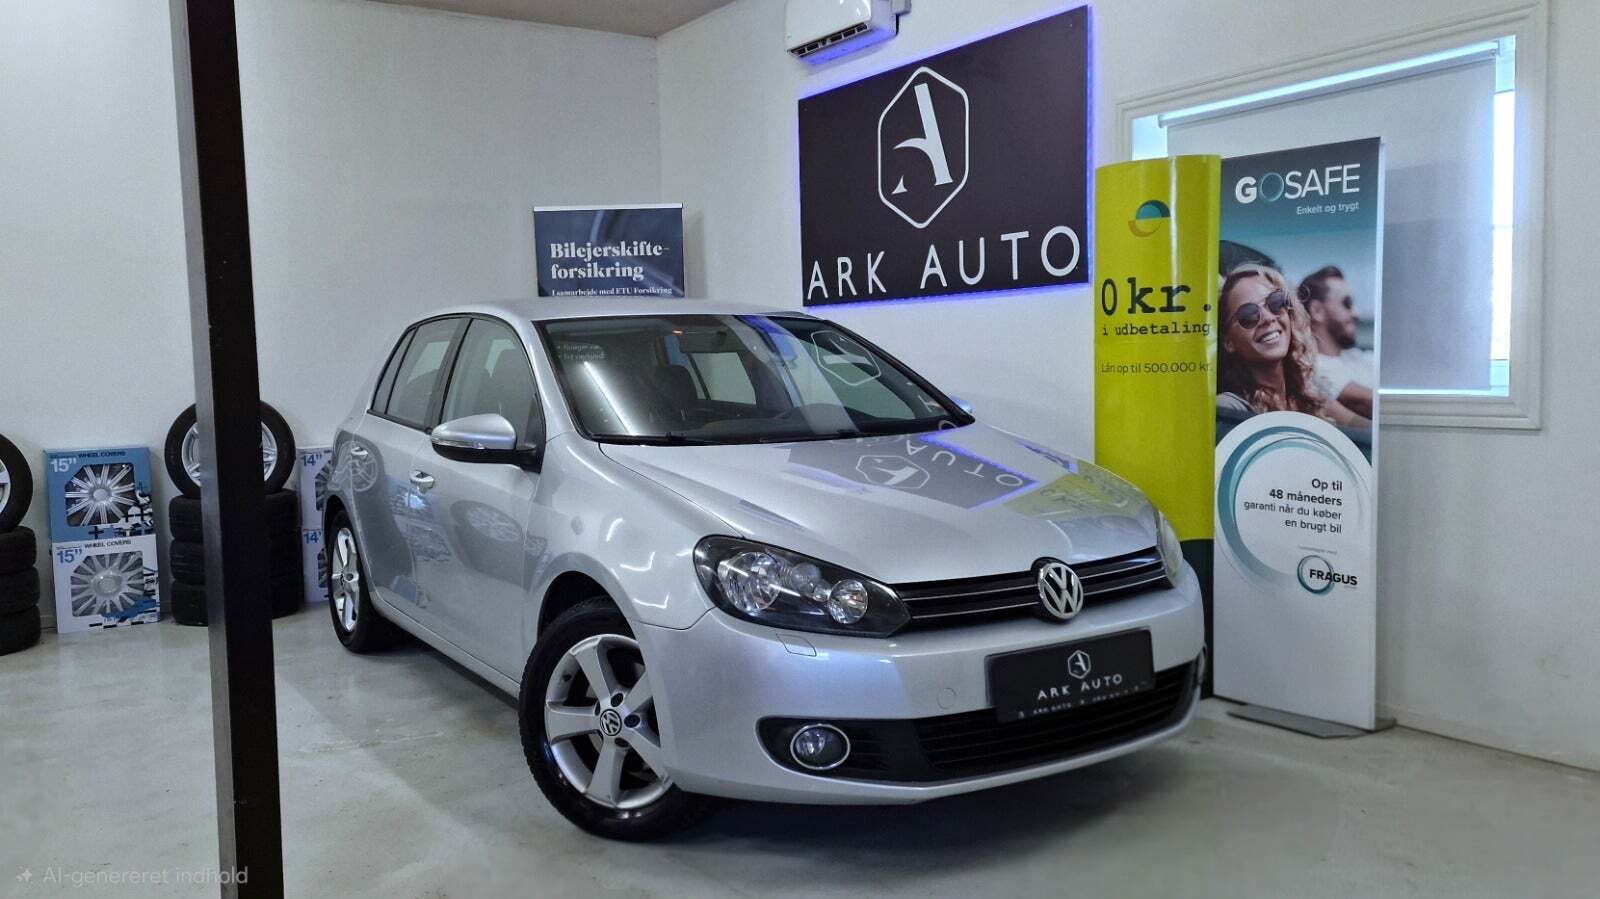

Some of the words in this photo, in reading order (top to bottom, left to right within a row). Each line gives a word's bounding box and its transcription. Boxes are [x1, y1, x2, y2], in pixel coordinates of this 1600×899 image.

[1235, 163, 1360, 204] GOSAFE
[1296, 206, 1322, 215] Enkelt
[1324, 205, 1336, 214] og
[1338, 202, 1360, 213] trygt
[550, 240, 670, 262] Bilejerskifte-
[551, 261, 645, 281] forsikring
[807, 250, 887, 300] ARK
[920, 225, 1080, 289] AUTO
[600, 287, 615, 295] med
[634, 285, 673, 295] Forsikring
[1101, 278, 1118, 316] 0
[1127, 276, 1212, 314] kr.
[1103, 324, 1109, 336] i
[1115, 320, 1211, 336] udbetaling
[1117, 364, 1129, 376] op
[1131, 362, 1141, 374] til
[1143, 361, 1197, 374] 500.000
[1311, 478, 1329, 492] Op
[1332, 480, 1343, 491] til
[1269, 488, 1284, 499] 48
[1287, 490, 1343, 506] måneders
[1244, 501, 1276, 511] garanti
[1278, 503, 1294, 514] når
[1297, 506, 1310, 516] du
[1313, 507, 1342, 520] køber
[1285, 519, 1298, 528] en
[1300, 520, 1327, 533] brugt
[1330, 523, 1342, 534] bil
[1309, 569, 1358, 586] FRAGUS
[1038, 684, 1071, 700] ARK
[1081, 673, 1122, 692] AUTO
